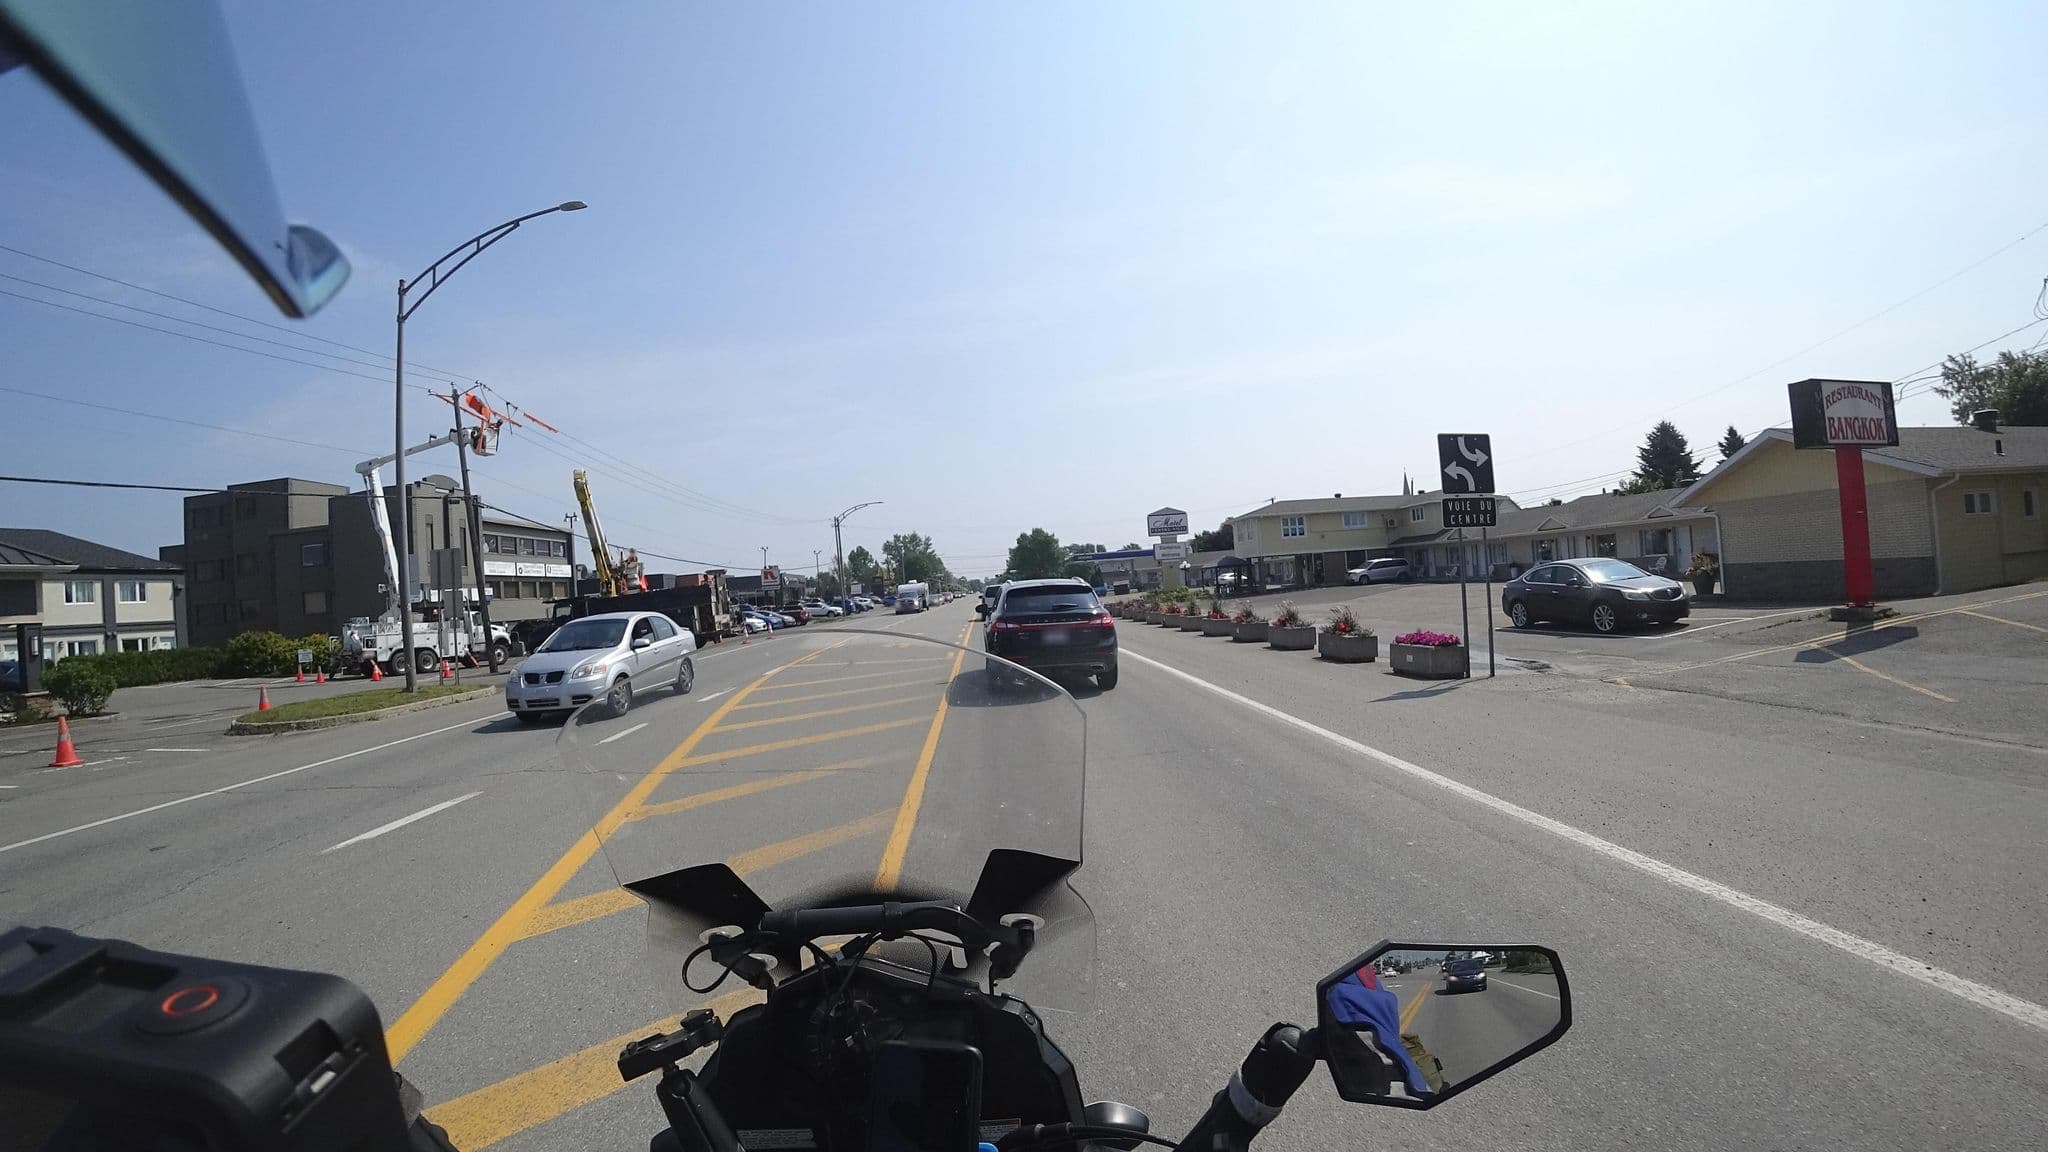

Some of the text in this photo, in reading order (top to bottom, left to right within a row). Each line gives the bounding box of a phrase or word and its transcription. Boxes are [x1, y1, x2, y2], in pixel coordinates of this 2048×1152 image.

[1824, 385, 1882, 410] RESTAURANT
[1827, 416, 1887, 440] BANGKOK
[1448, 500, 1492, 511] VOIE DU
[1450, 514, 1492, 525] CENTRE
